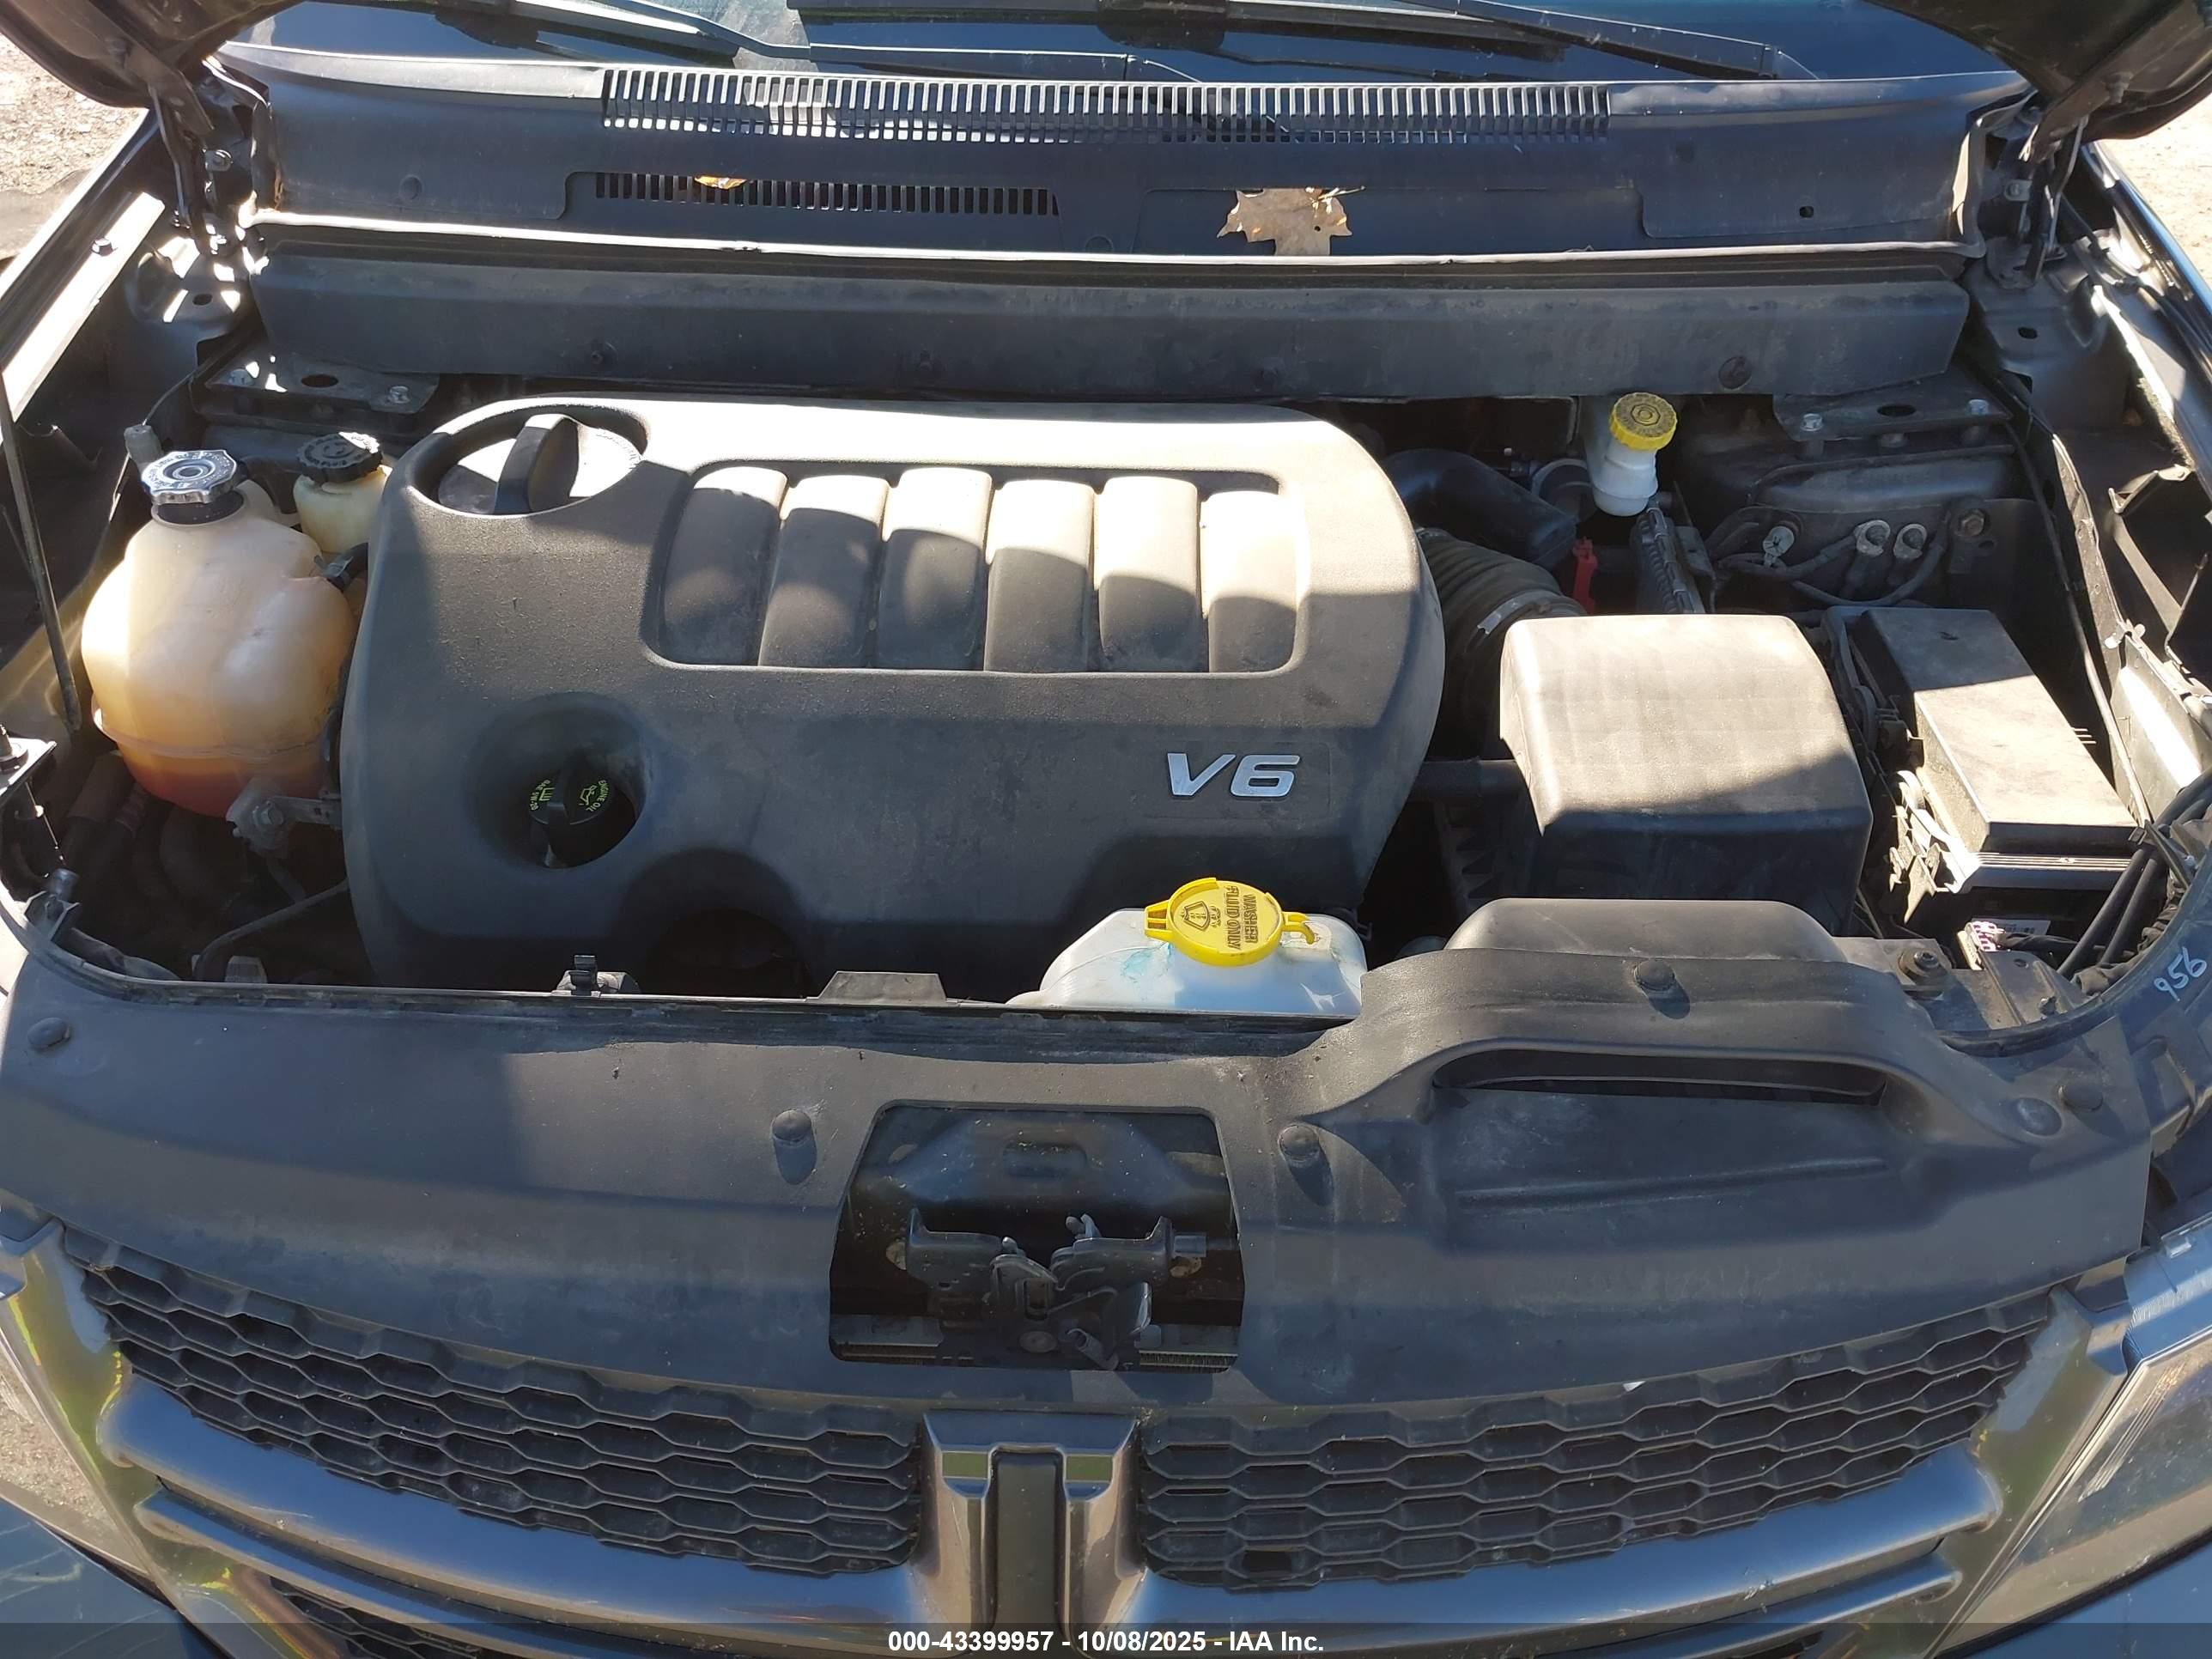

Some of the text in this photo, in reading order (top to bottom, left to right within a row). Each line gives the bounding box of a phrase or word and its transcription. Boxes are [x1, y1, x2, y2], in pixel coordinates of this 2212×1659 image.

[586, 779, 609, 812] ENGINE OIL
[1167, 752, 1301, 798] V6
[1225, 885, 1242, 951] FLUID ONLY
[1243, 893, 1259, 944] WASHER
[2154, 946, 2208, 1002] 956
